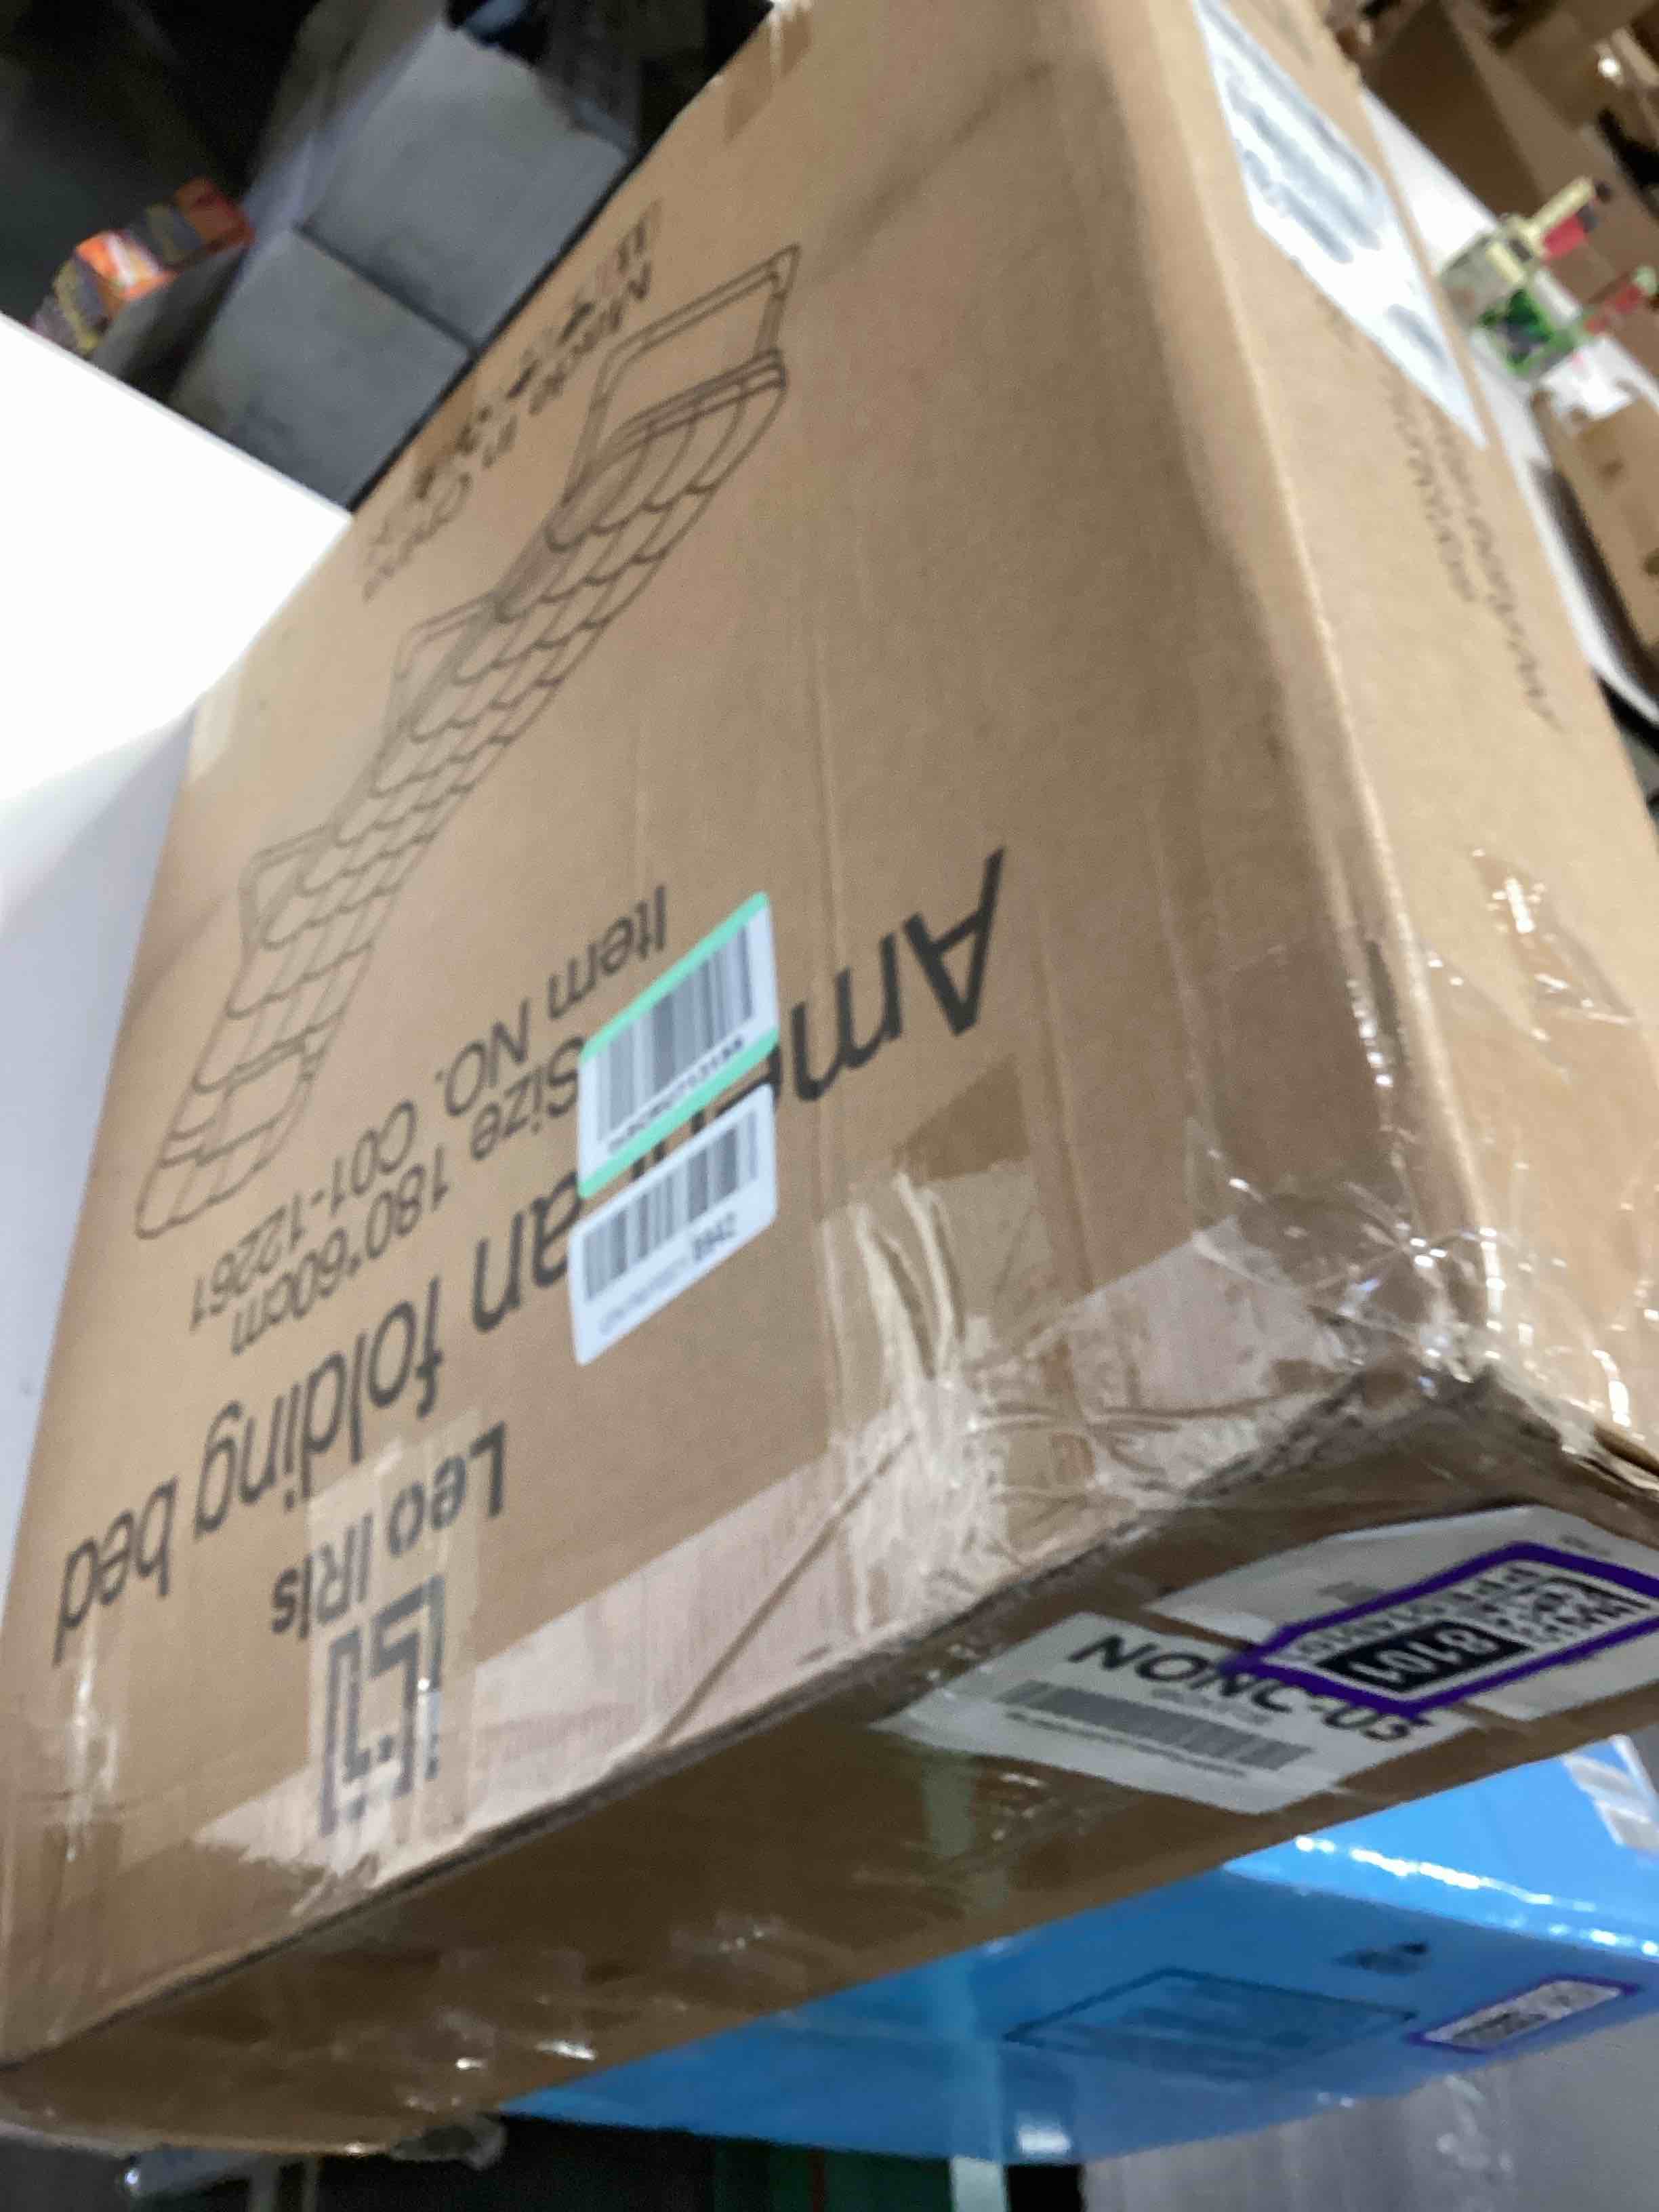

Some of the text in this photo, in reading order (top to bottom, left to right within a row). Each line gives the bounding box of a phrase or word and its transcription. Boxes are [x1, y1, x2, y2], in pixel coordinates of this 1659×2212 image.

[547, 884, 667, 1020] Item
[470, 1035, 585, 1161] Size
[193, 1275, 444, 1539] folding
[387, 1420, 506, 1556] Leo
[52, 1475, 178, 1668] bed
